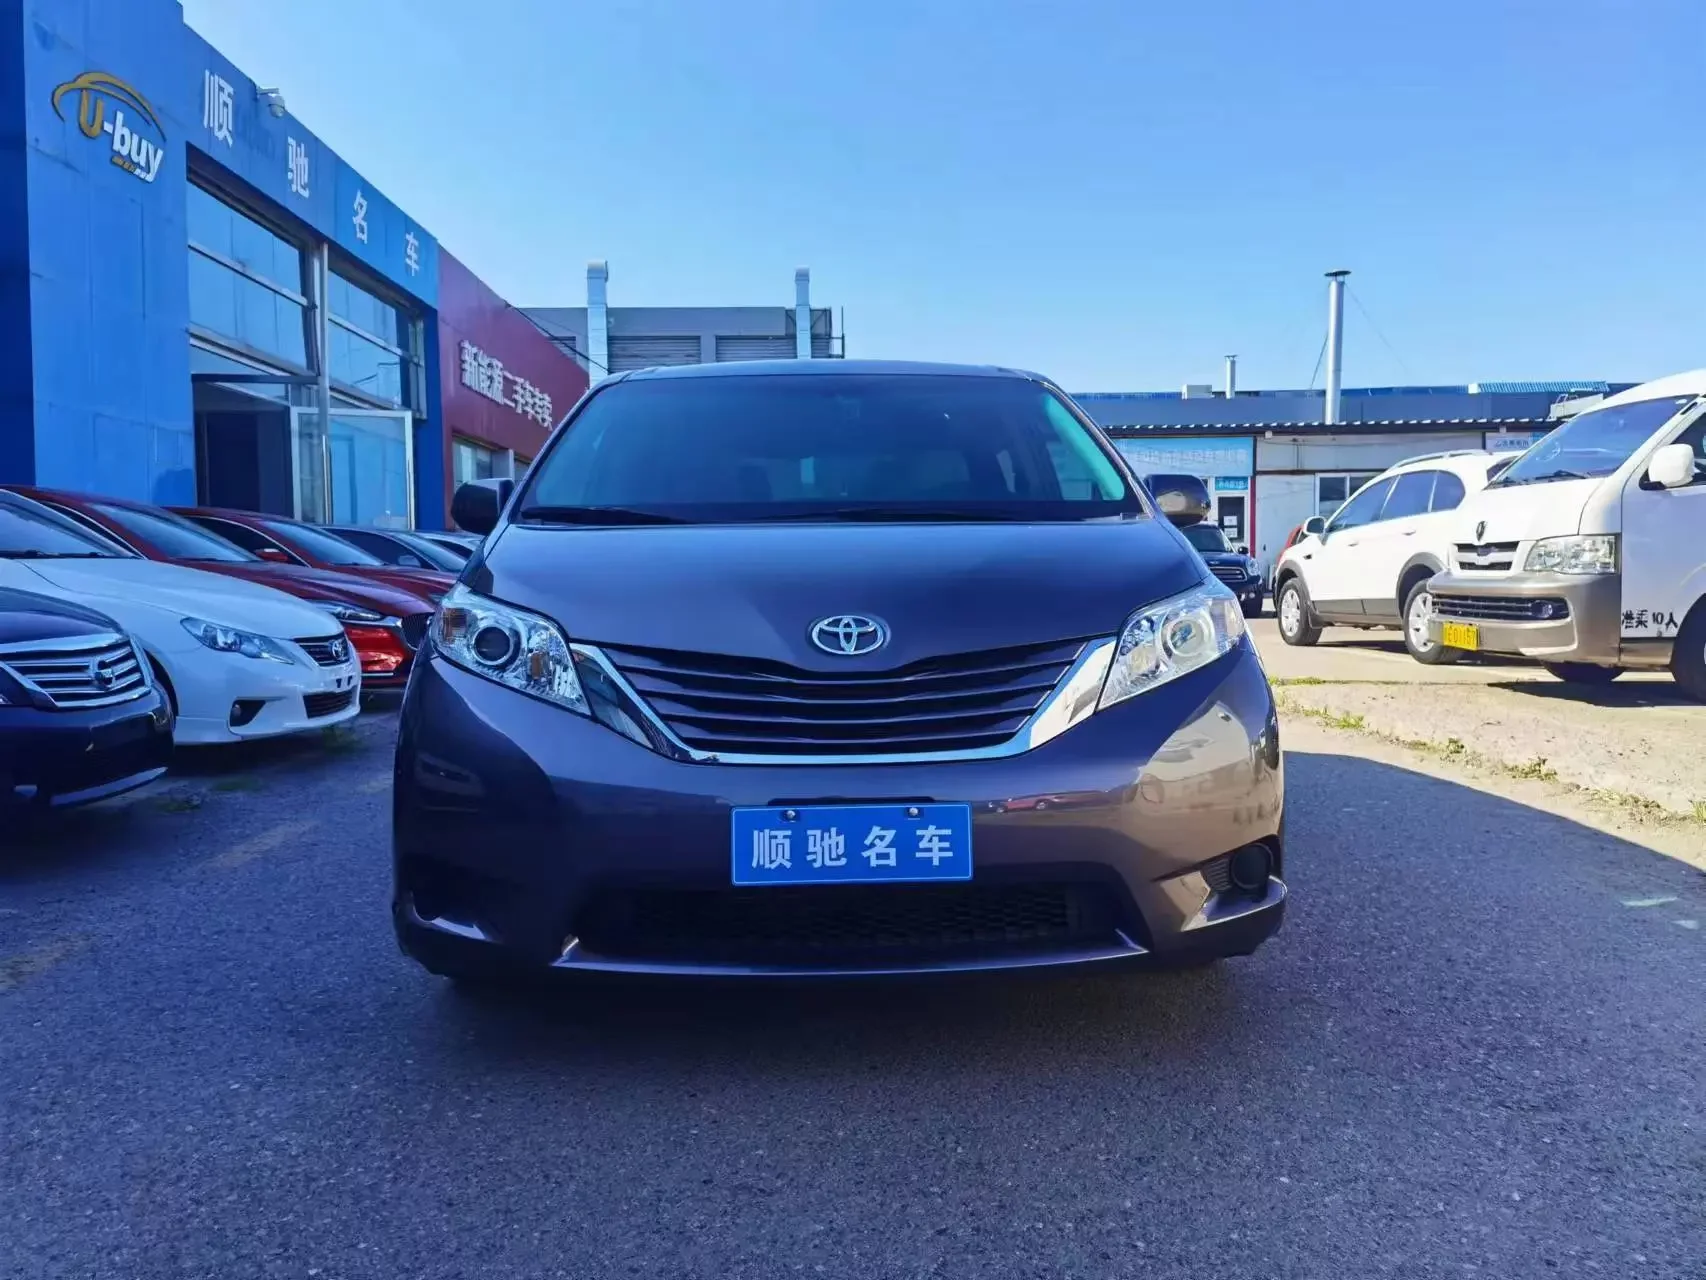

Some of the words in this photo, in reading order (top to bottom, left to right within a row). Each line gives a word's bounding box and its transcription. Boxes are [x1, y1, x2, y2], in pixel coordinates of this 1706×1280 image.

[79, 88, 164, 182] U-buy
[203, 68, 420, 277] 顺驰名车
[460, 339, 553, 431] 新能源二手车专卖
[751, 824, 954, 869] 顺驰名车
